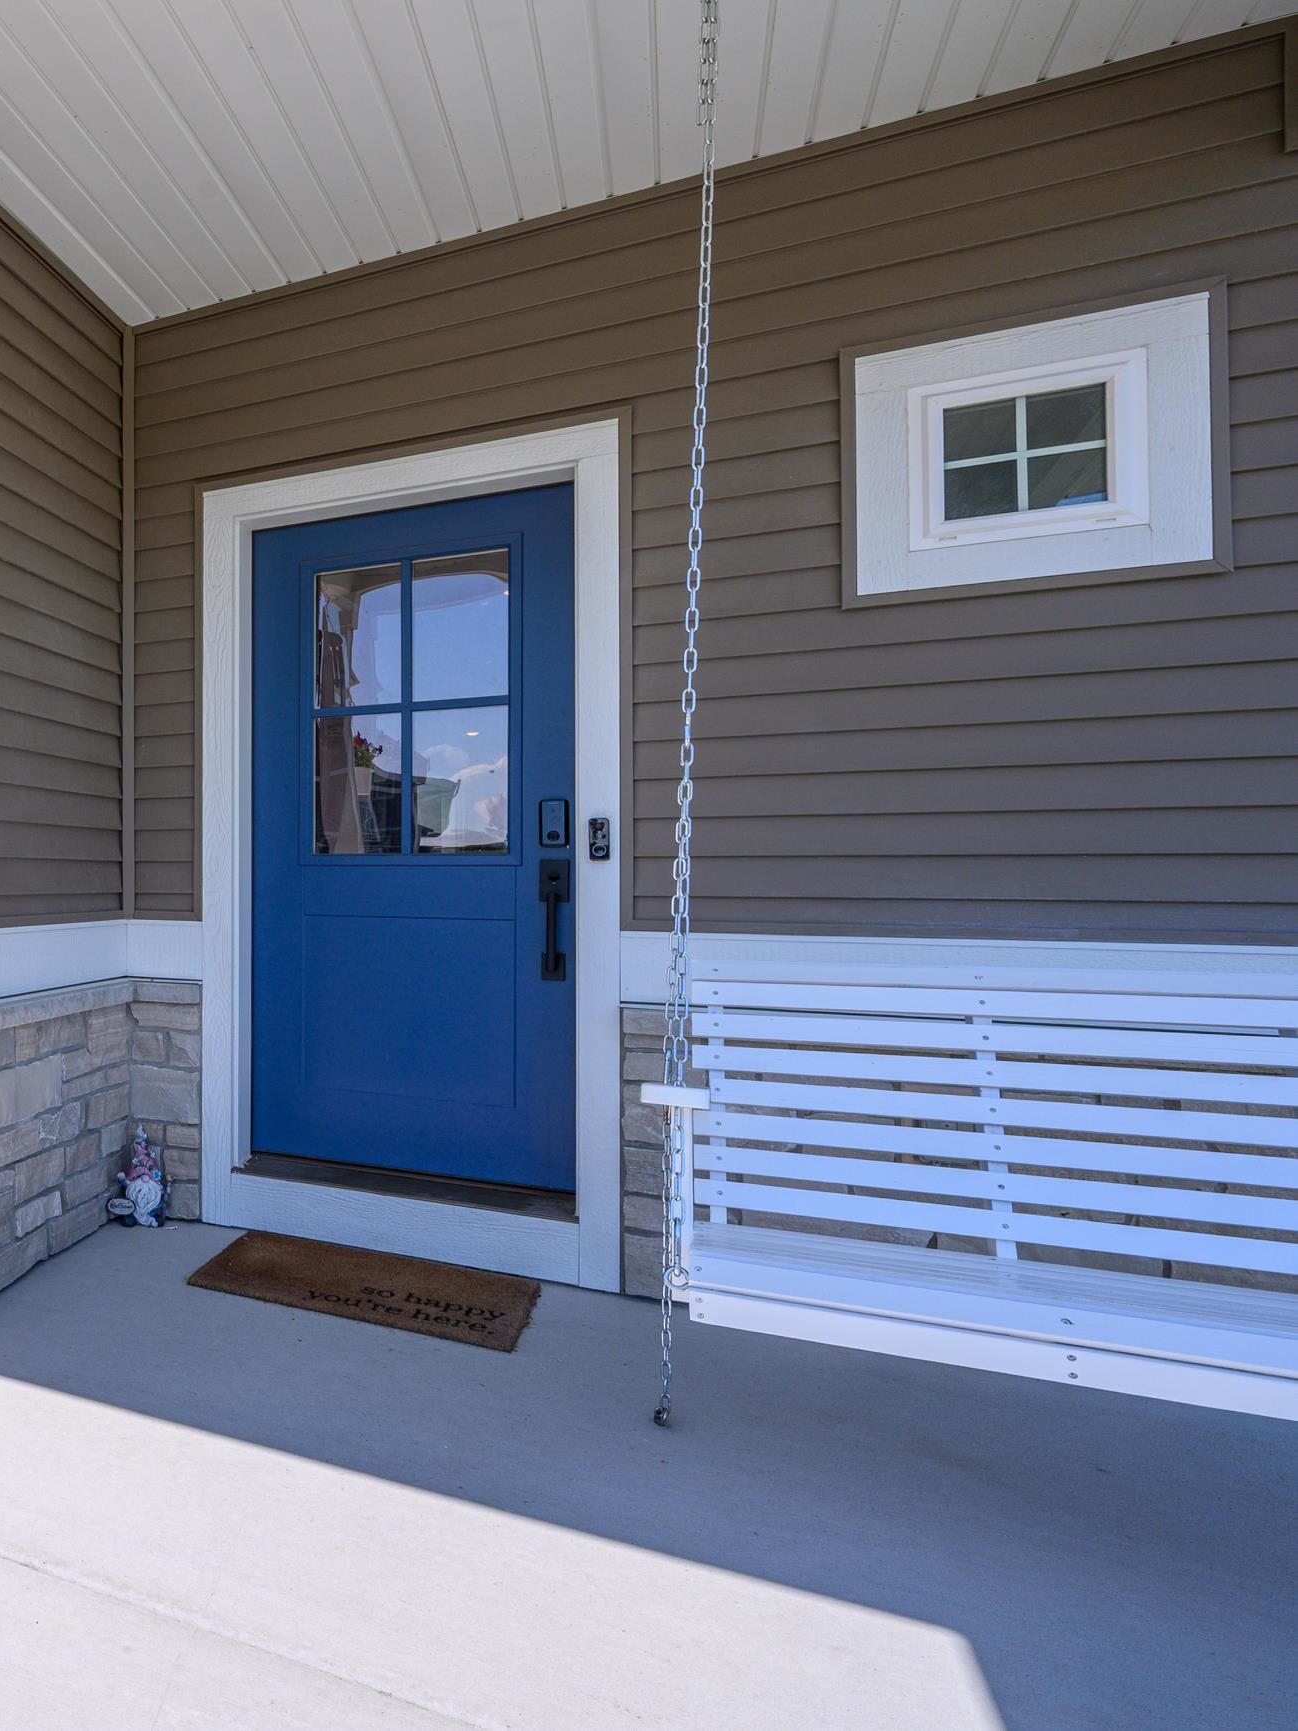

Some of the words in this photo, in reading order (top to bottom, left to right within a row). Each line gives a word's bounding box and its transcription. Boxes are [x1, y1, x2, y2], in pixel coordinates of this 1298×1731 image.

[302, 1289, 404, 1315] you're
[411, 1308, 494, 1335] here.
[359, 1285, 395, 1299] so
[405, 1291, 506, 1321] happy
